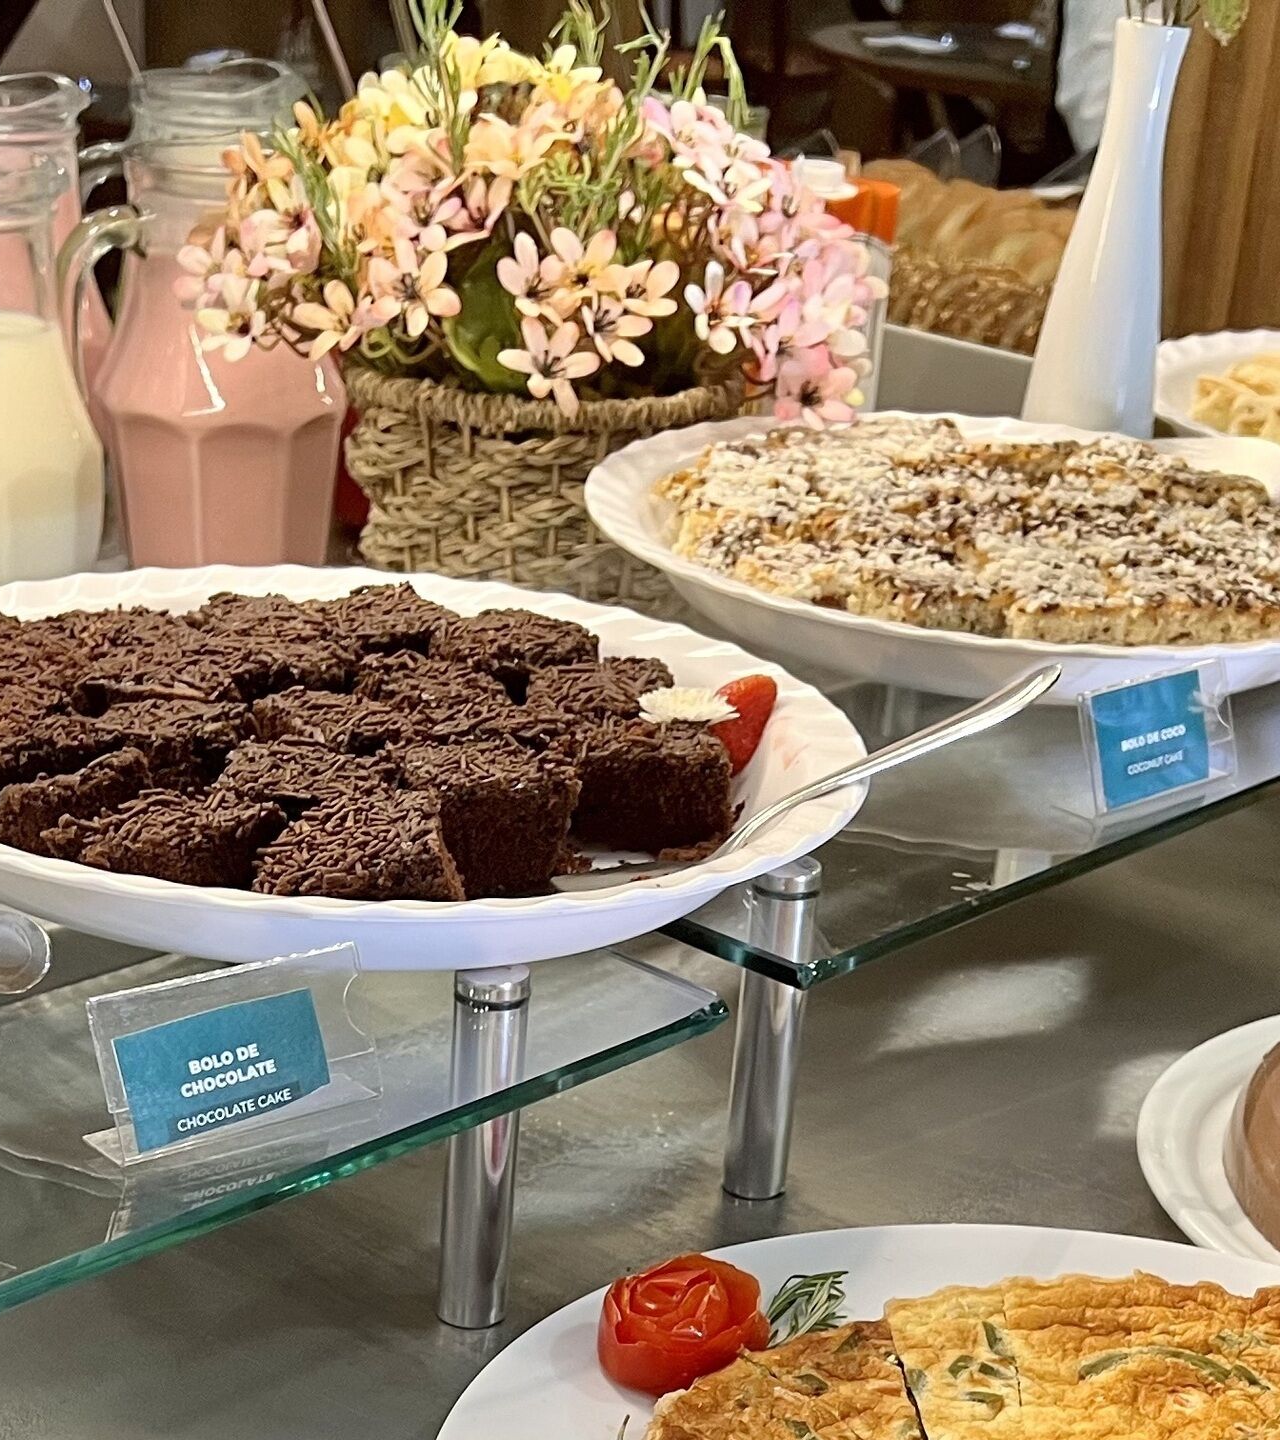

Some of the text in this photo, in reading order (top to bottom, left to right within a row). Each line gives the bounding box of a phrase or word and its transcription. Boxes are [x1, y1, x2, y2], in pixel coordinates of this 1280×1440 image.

[1121, 724, 1186, 752] BOLO DE COCO
[1127, 749, 1184, 776] COCONUT CAKE
[188, 1043, 260, 1075] BOLO DE
[180, 1059, 277, 1098] CHOCOLATE
[177, 1088, 292, 1132] CHOCOLATE CAKE
